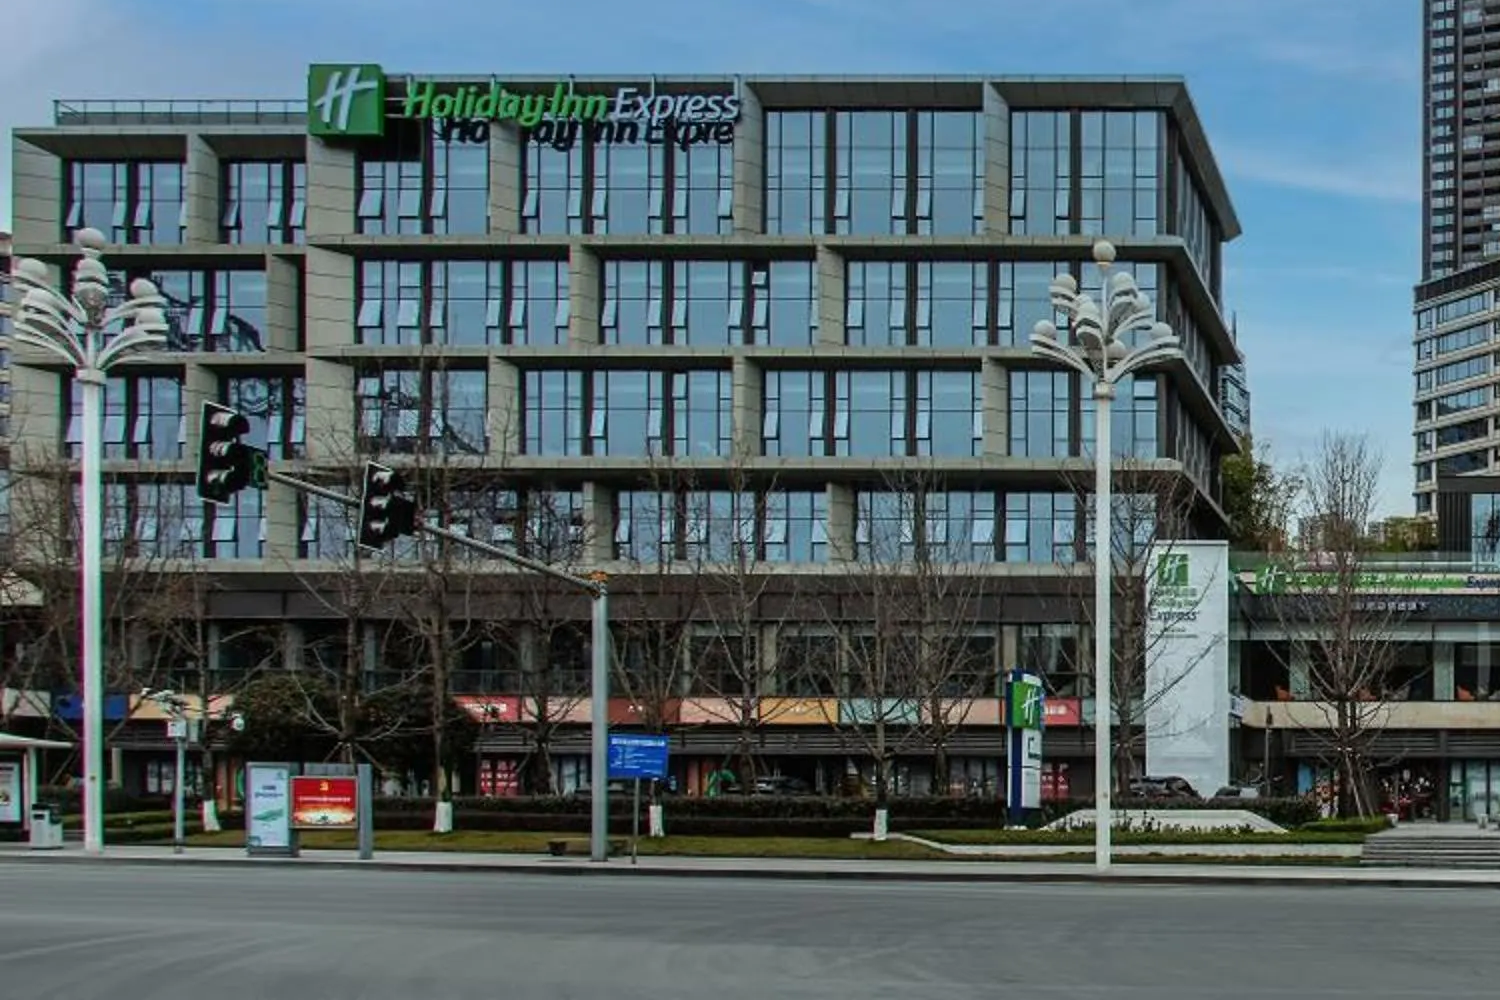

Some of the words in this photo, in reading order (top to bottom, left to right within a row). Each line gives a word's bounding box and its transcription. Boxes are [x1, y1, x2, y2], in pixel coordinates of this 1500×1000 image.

[403, 80, 545, 127] Holiday
[549, 83, 608, 121] Inn
[612, 87, 740, 127] Express
